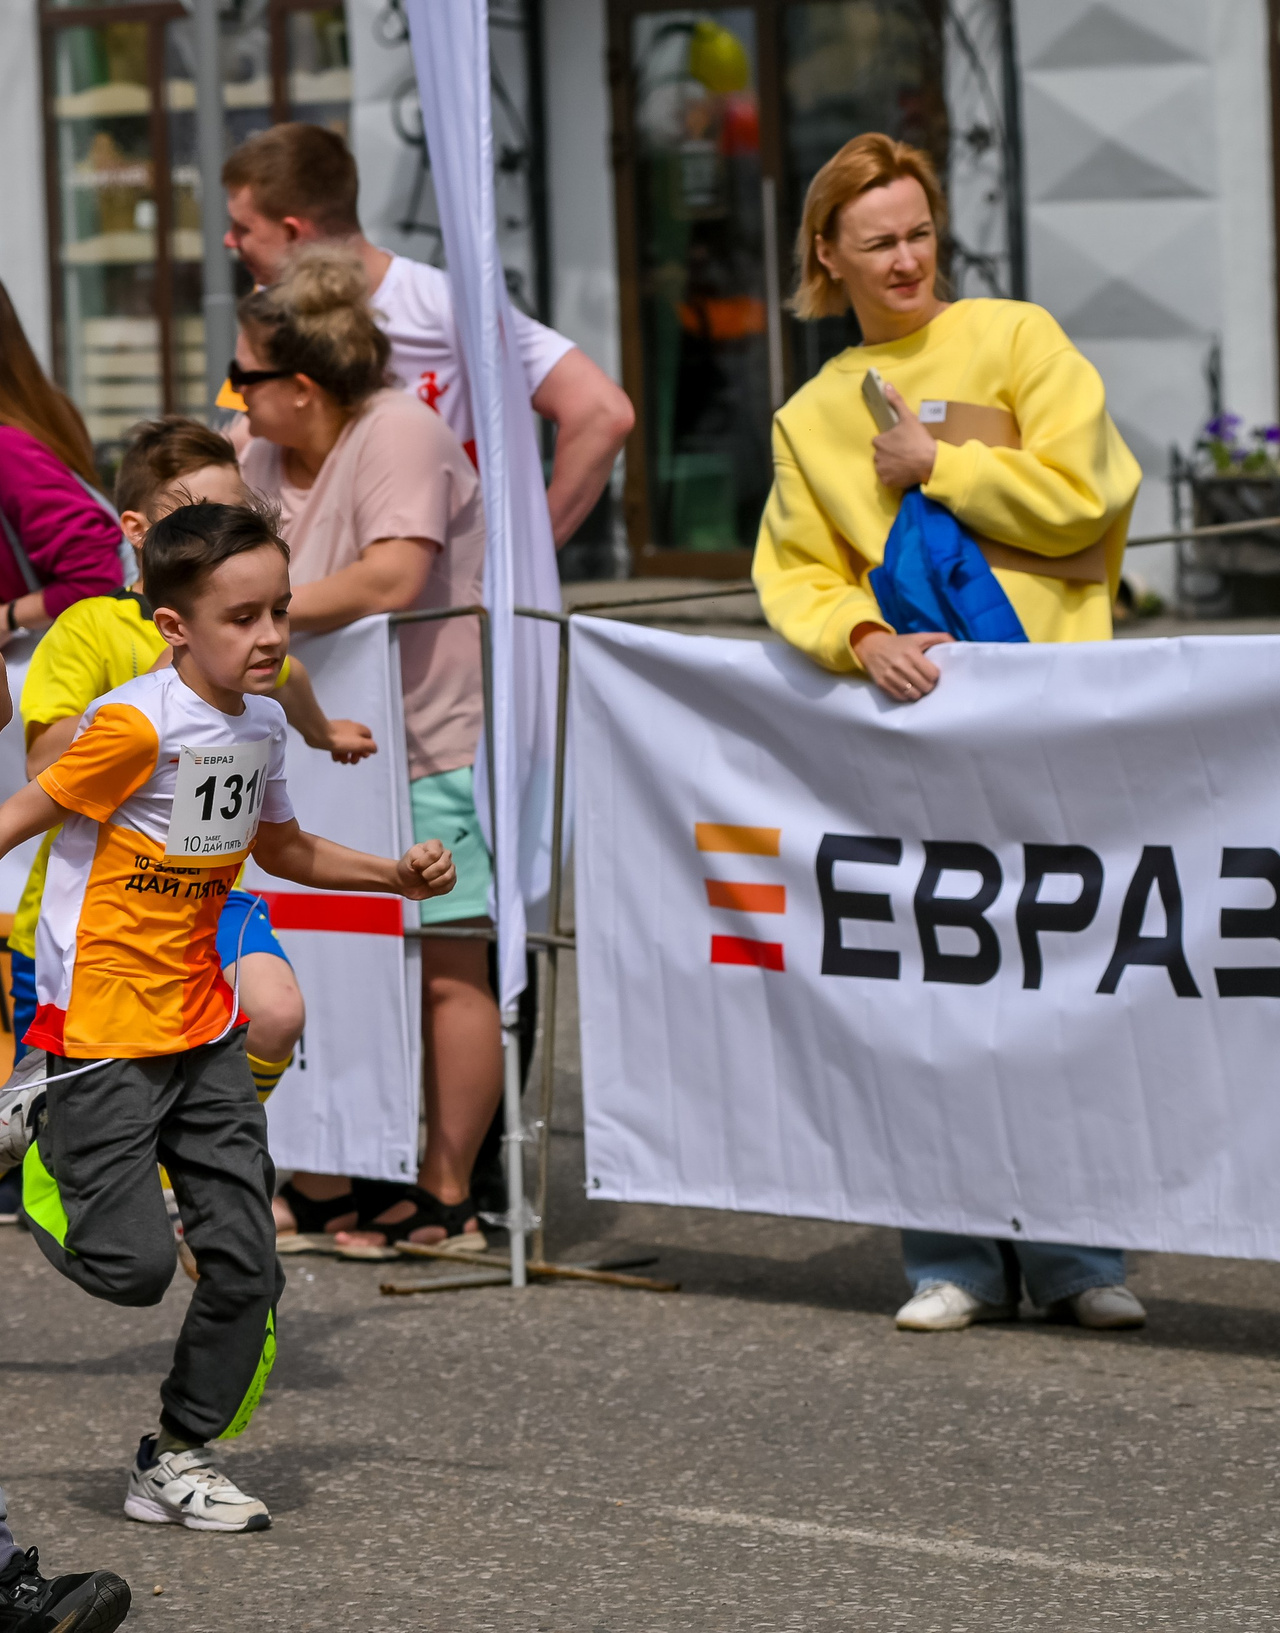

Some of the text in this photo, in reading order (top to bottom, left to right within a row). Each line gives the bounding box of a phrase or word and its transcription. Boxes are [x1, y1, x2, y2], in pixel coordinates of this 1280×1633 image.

[203, 755, 234, 765] ЕВРАЗ
[183, 836, 242, 853] 10 ДАЙ ПЯТЬ
[135, 855, 150, 870] 10
[125, 874, 181, 898] ДАЙ
[816, 834, 1280, 998] ЕВРАЗ
